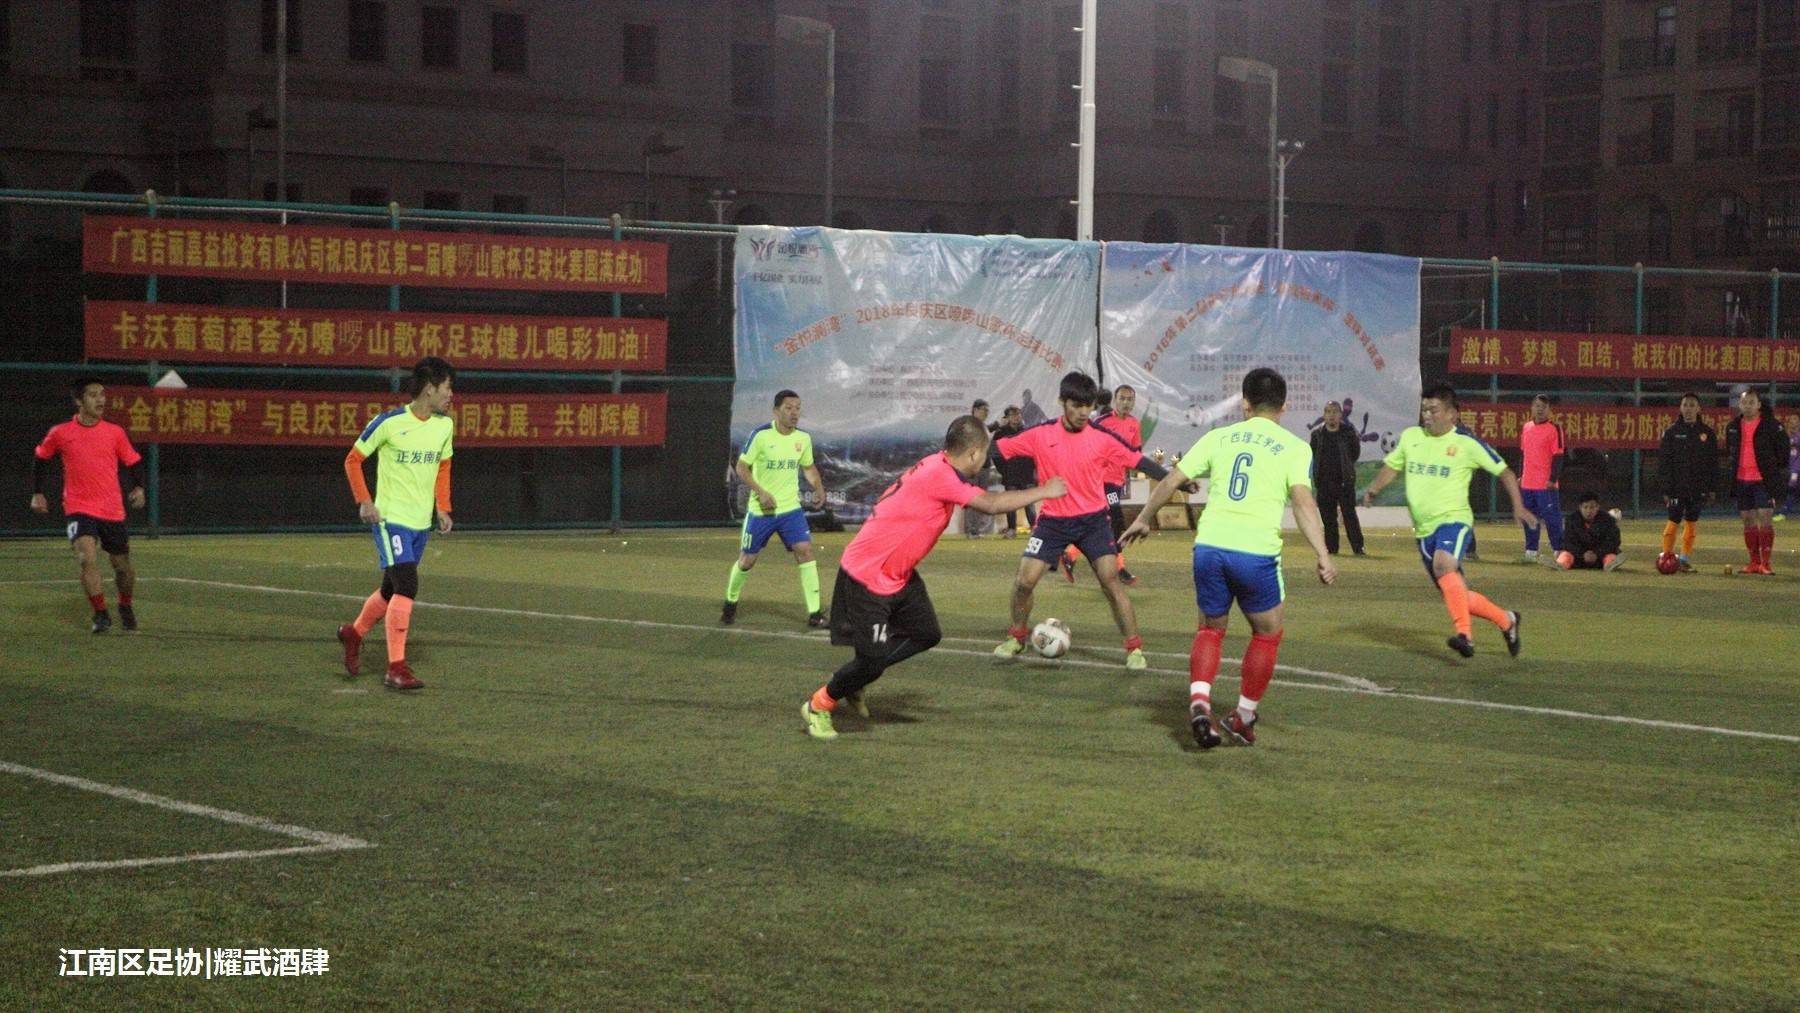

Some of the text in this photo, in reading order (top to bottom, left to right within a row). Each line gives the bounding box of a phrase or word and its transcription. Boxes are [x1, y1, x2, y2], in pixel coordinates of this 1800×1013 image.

[766, 459, 800, 470] 正发南
[1228, 451, 1253, 501] 6
[391, 534, 404, 555] 9
